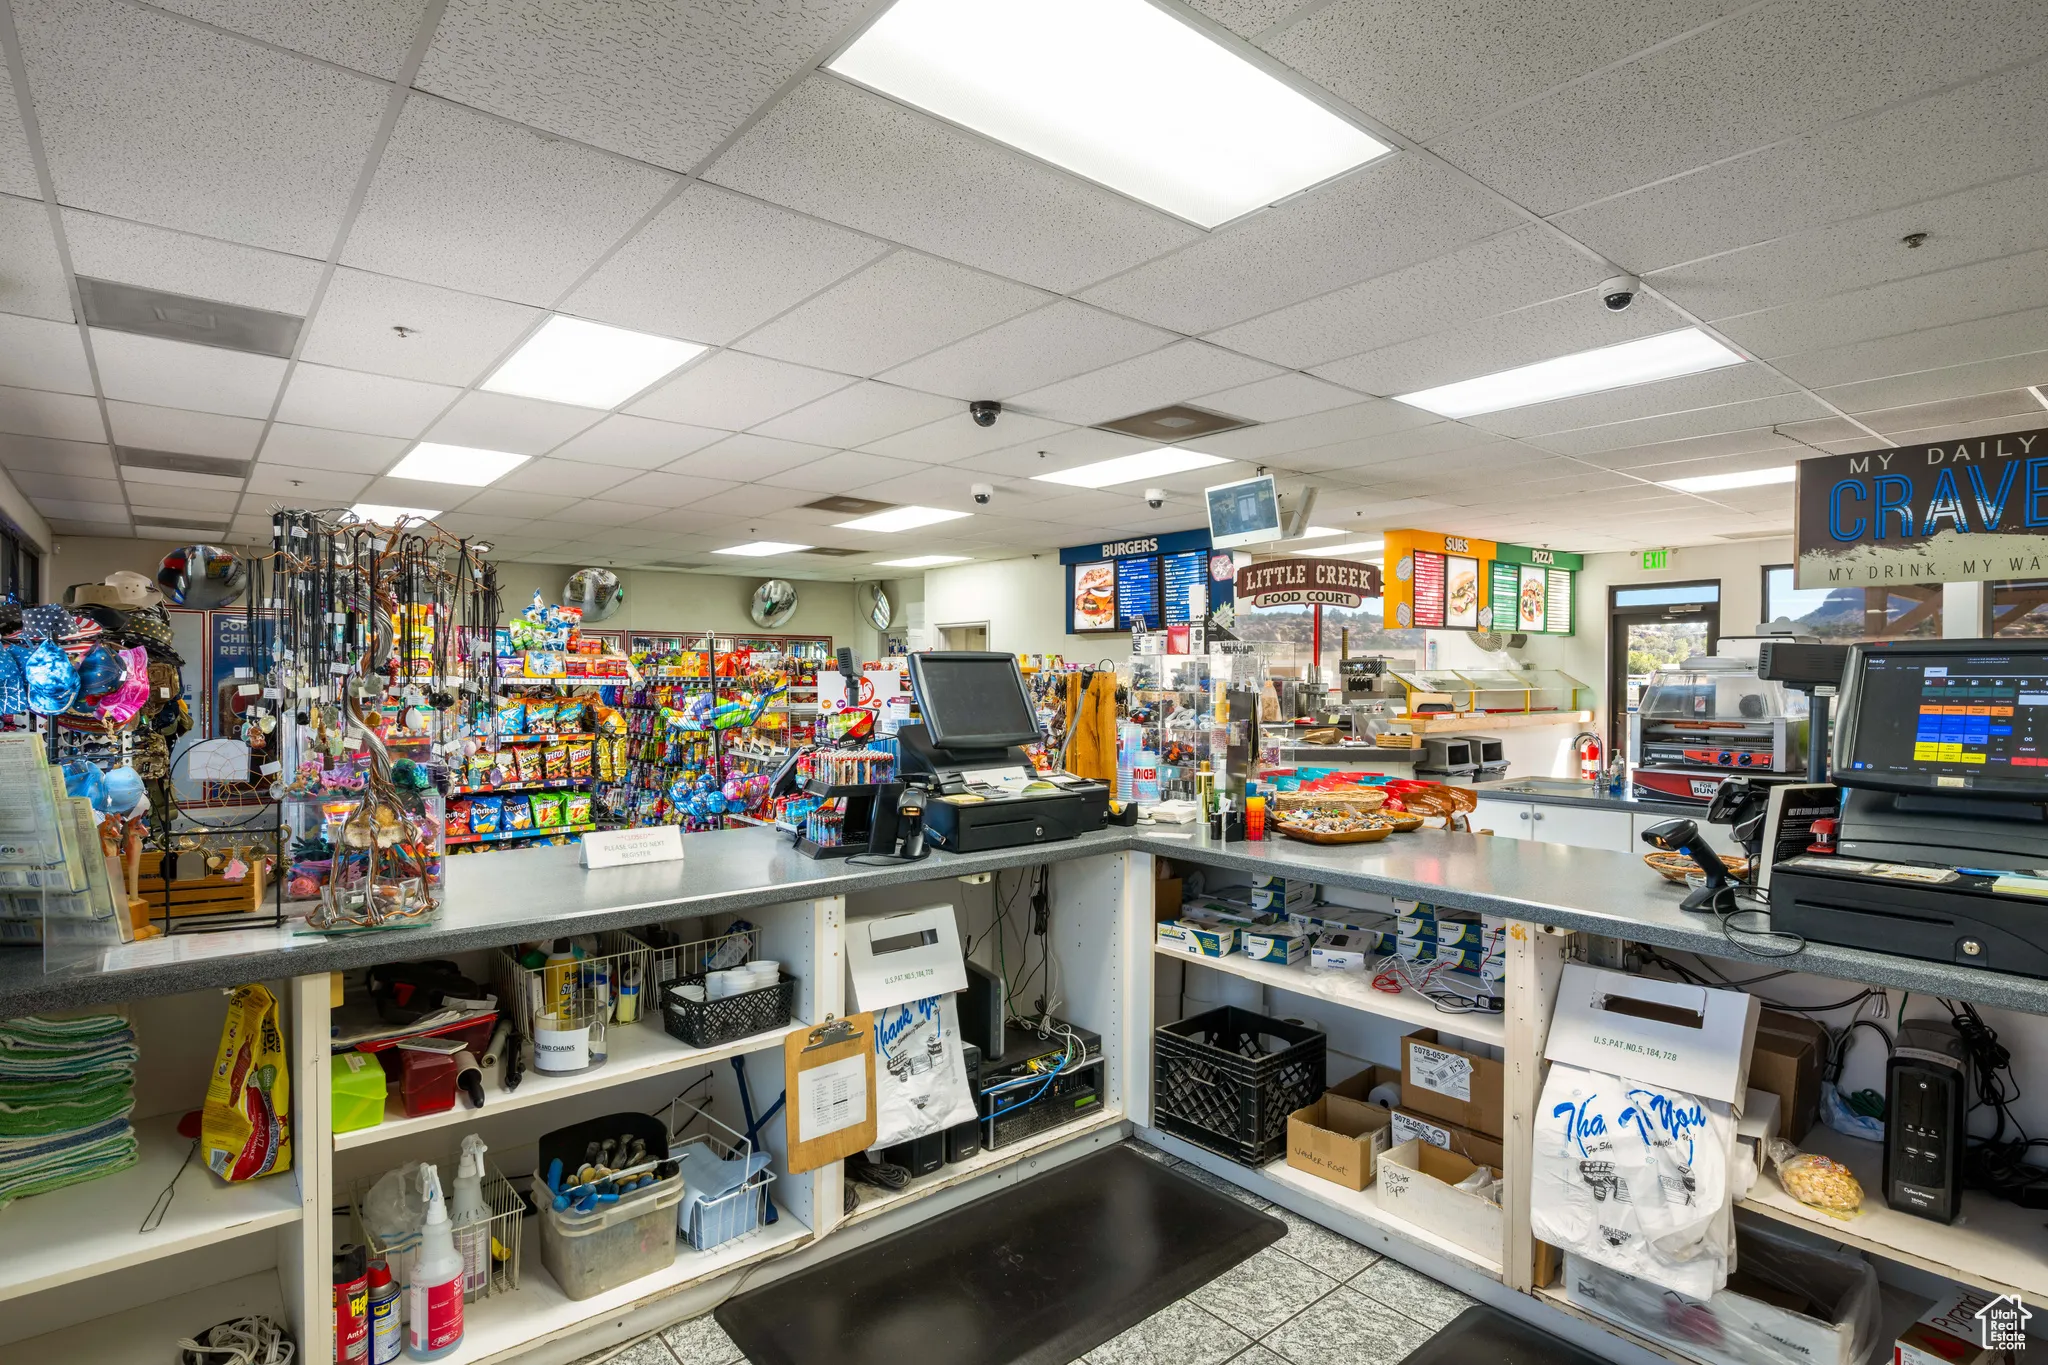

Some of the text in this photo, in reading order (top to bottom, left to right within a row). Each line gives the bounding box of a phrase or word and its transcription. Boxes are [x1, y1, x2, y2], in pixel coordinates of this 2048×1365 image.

[1850, 435, 2038, 474] MY DAILY
[1829, 457, 2048, 542] CRAVE
[1102, 538, 1158, 557] BURGERS
[1445, 537, 1469, 553] SUBS
[1531, 550, 1554, 564] PIZZA
[1643, 550, 1668, 570] EXIT
[1246, 564, 1307, 591] LITTLE
[1315, 563, 1371, 591] CREEK
[1829, 568, 1854, 582] MY
[1963, 558, 1993, 574] MY
[1263, 591, 1352, 605] FOOD COURT
[570, 750, 592, 761] Fritos
[470, 805, 499, 814] Doritos
[503, 802, 529, 812] Doritos
[445, 810, 467, 819] oritos
[604, 844, 626, 852] PLEASE
[649, 840, 665, 848] NEXT
[621, 850, 651, 859] REGISTER
[553, 1044, 576, 1052] CHAINS
[1385, 1181, 1409, 1198] Paper
[1903, 1186, 1935, 1200] CyberPower
[347, 1332, 359, 1341] Ant
